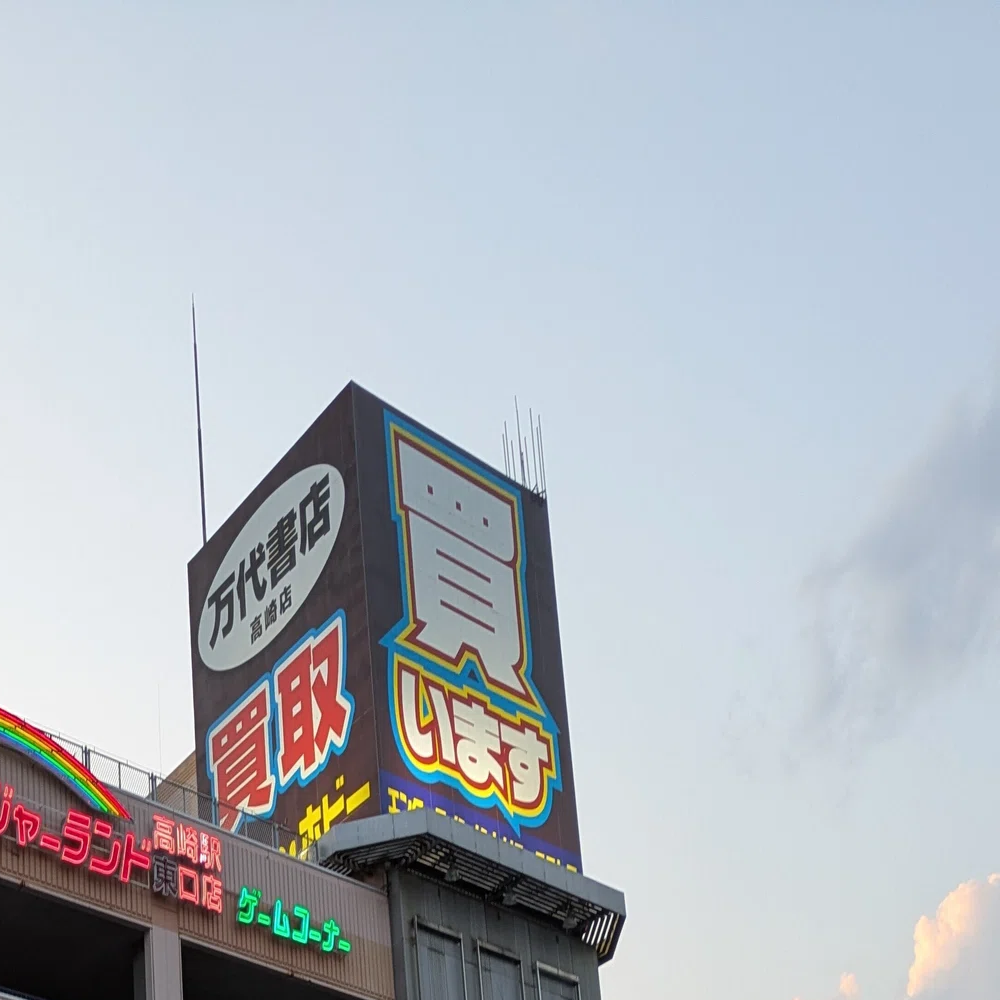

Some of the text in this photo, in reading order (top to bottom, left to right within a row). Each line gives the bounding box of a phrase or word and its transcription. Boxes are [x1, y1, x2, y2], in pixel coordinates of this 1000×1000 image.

[207, 471, 331, 651] 万代書店
[396, 434, 536, 706] 買
[250, 583, 293, 645] 高崎店
[210, 625, 347, 832] 買取
[398, 666, 552, 807] います
[152, 813, 223, 872] 高崎駅
[152, 856, 223, 914] 東口店
[237, 885, 352, 953] ゲームコーナー
